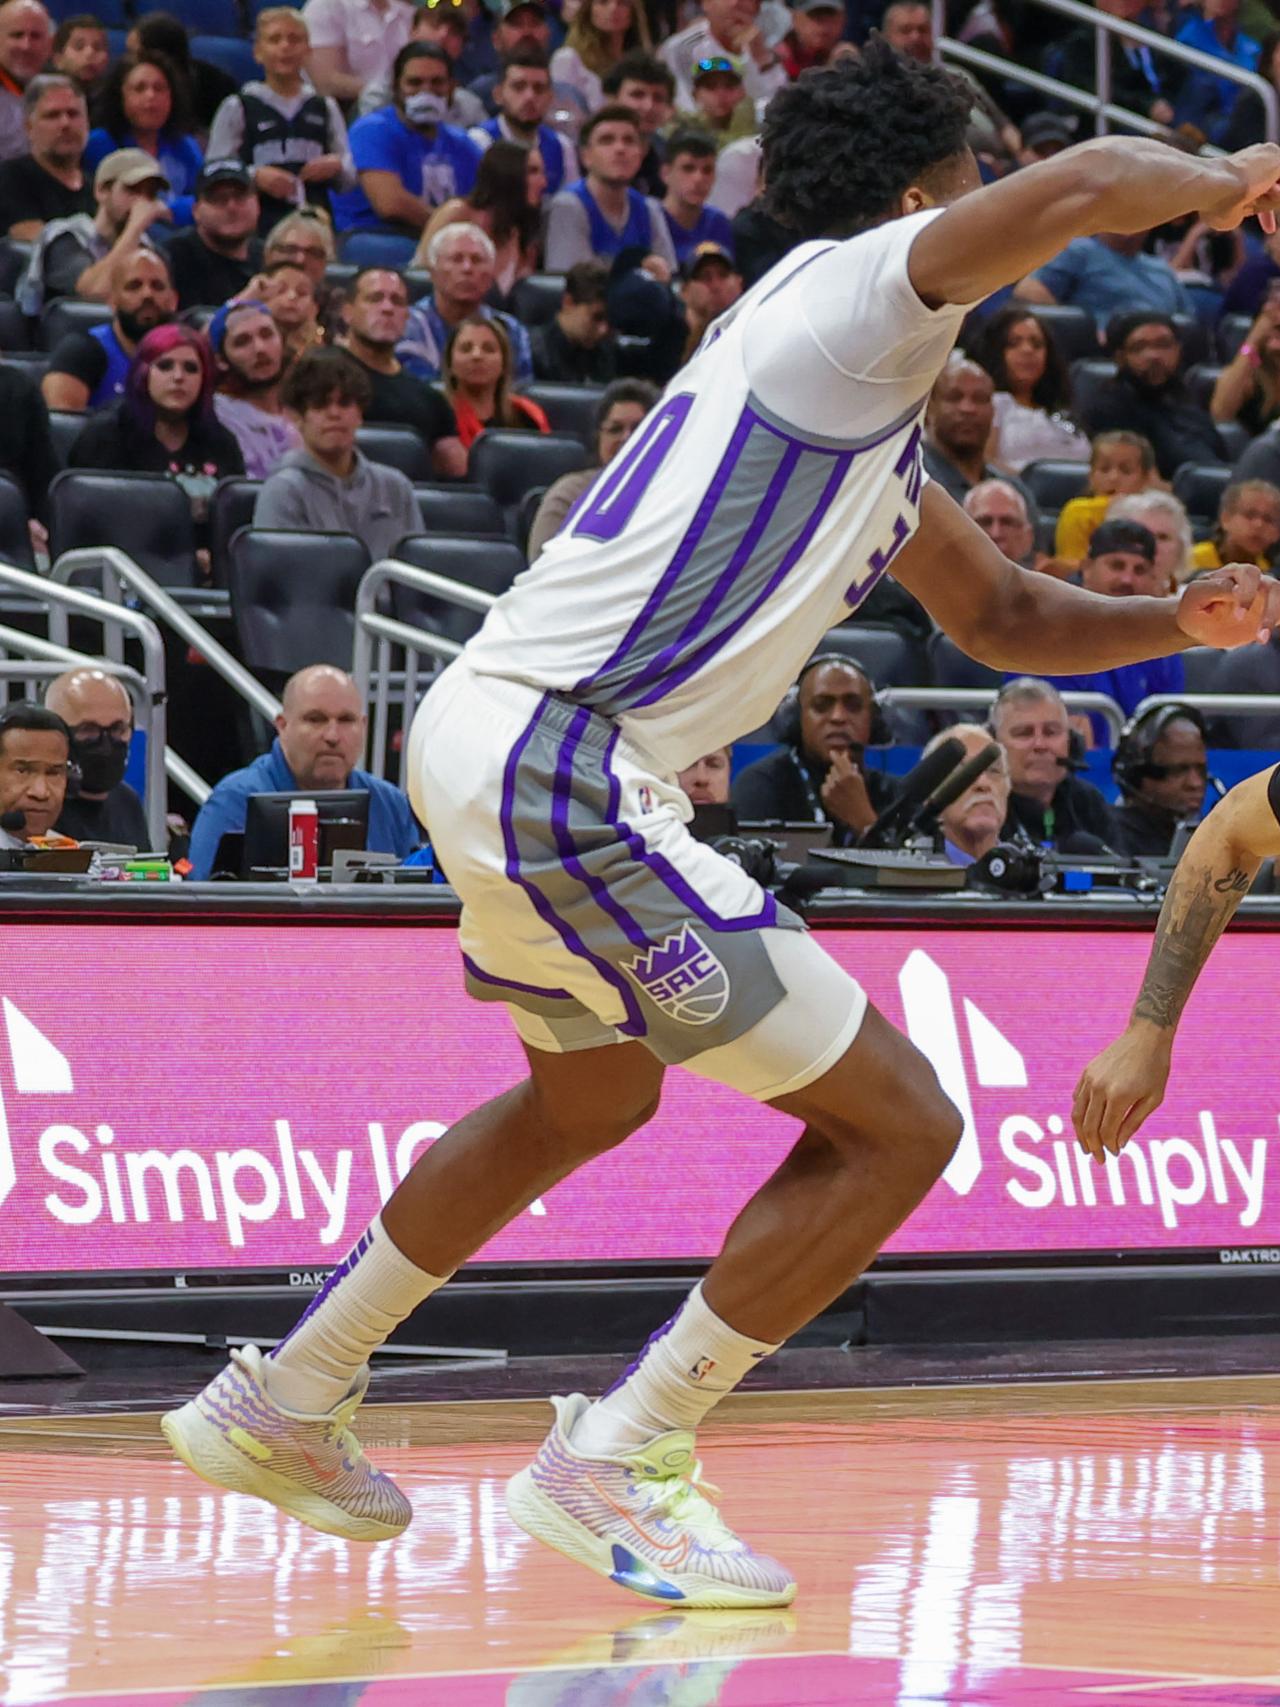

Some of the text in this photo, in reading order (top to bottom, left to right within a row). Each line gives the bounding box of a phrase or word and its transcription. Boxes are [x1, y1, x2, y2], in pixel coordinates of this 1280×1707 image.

[559, 390, 697, 544] 0
[646, 951, 718, 1002] SAC
[38, 1119, 353, 1247] Simply
[998, 1110, 1268, 1229] Simply
